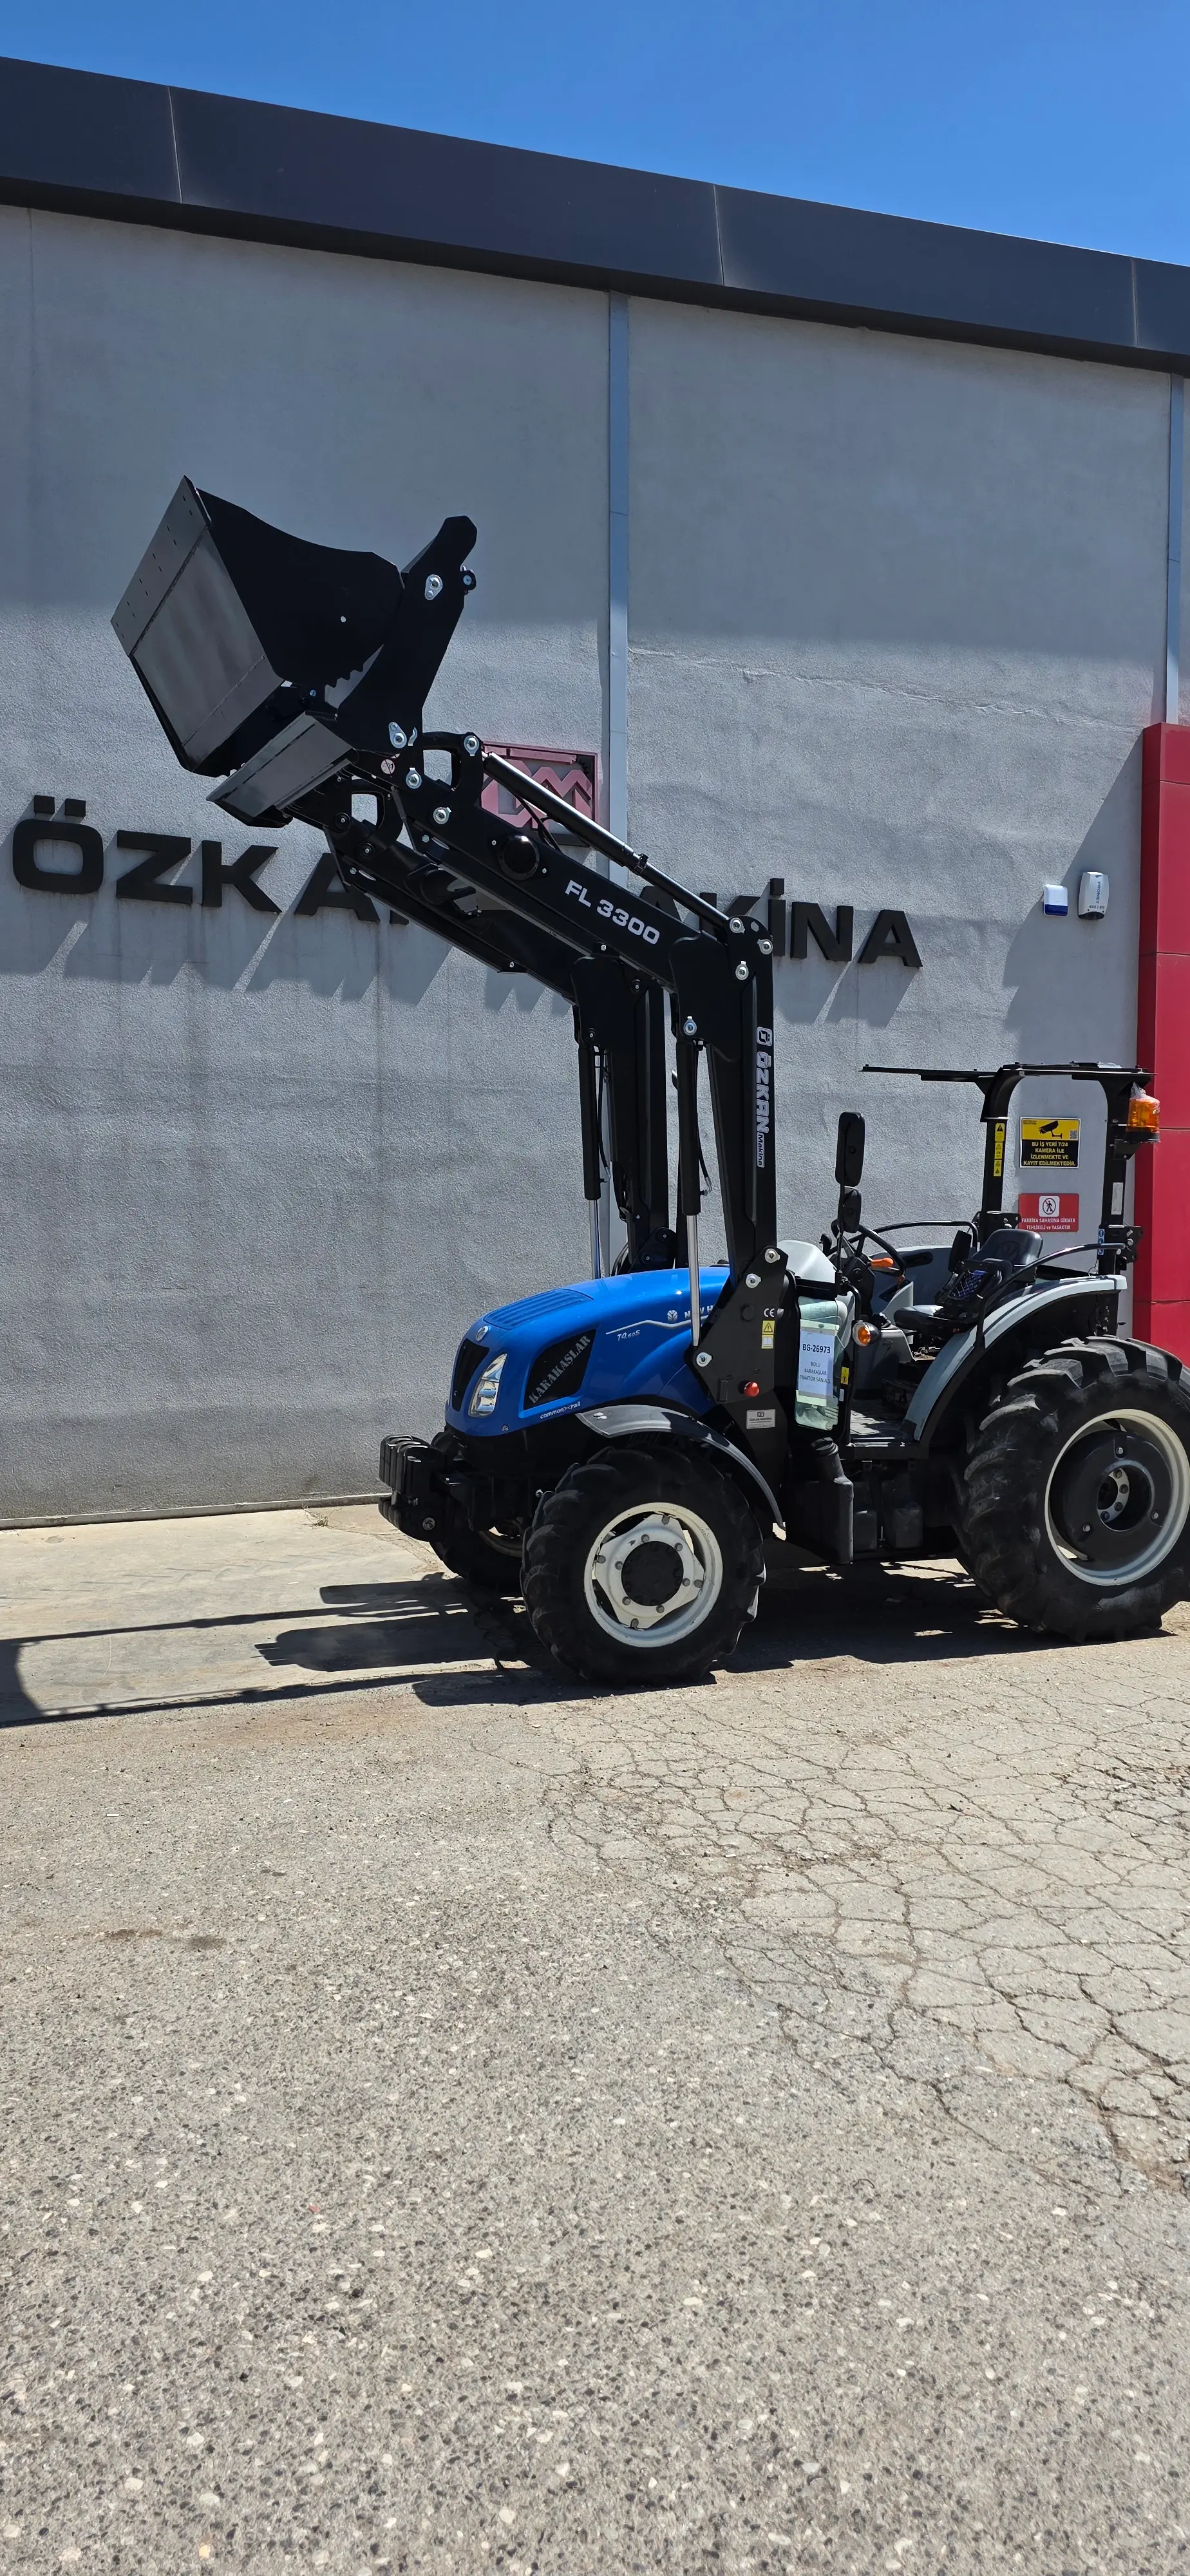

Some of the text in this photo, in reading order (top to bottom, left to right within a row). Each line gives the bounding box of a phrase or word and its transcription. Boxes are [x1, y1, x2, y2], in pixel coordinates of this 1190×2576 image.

[12, 794, 410, 926] ÖZKA
[565, 880, 660, 945] FL 3300
[757, 1051, 771, 1133] ÖZKAN
[528, 1336, 591, 1404] KARAKAŞLAR
[802, 1343, 831, 1354] BG-26973
